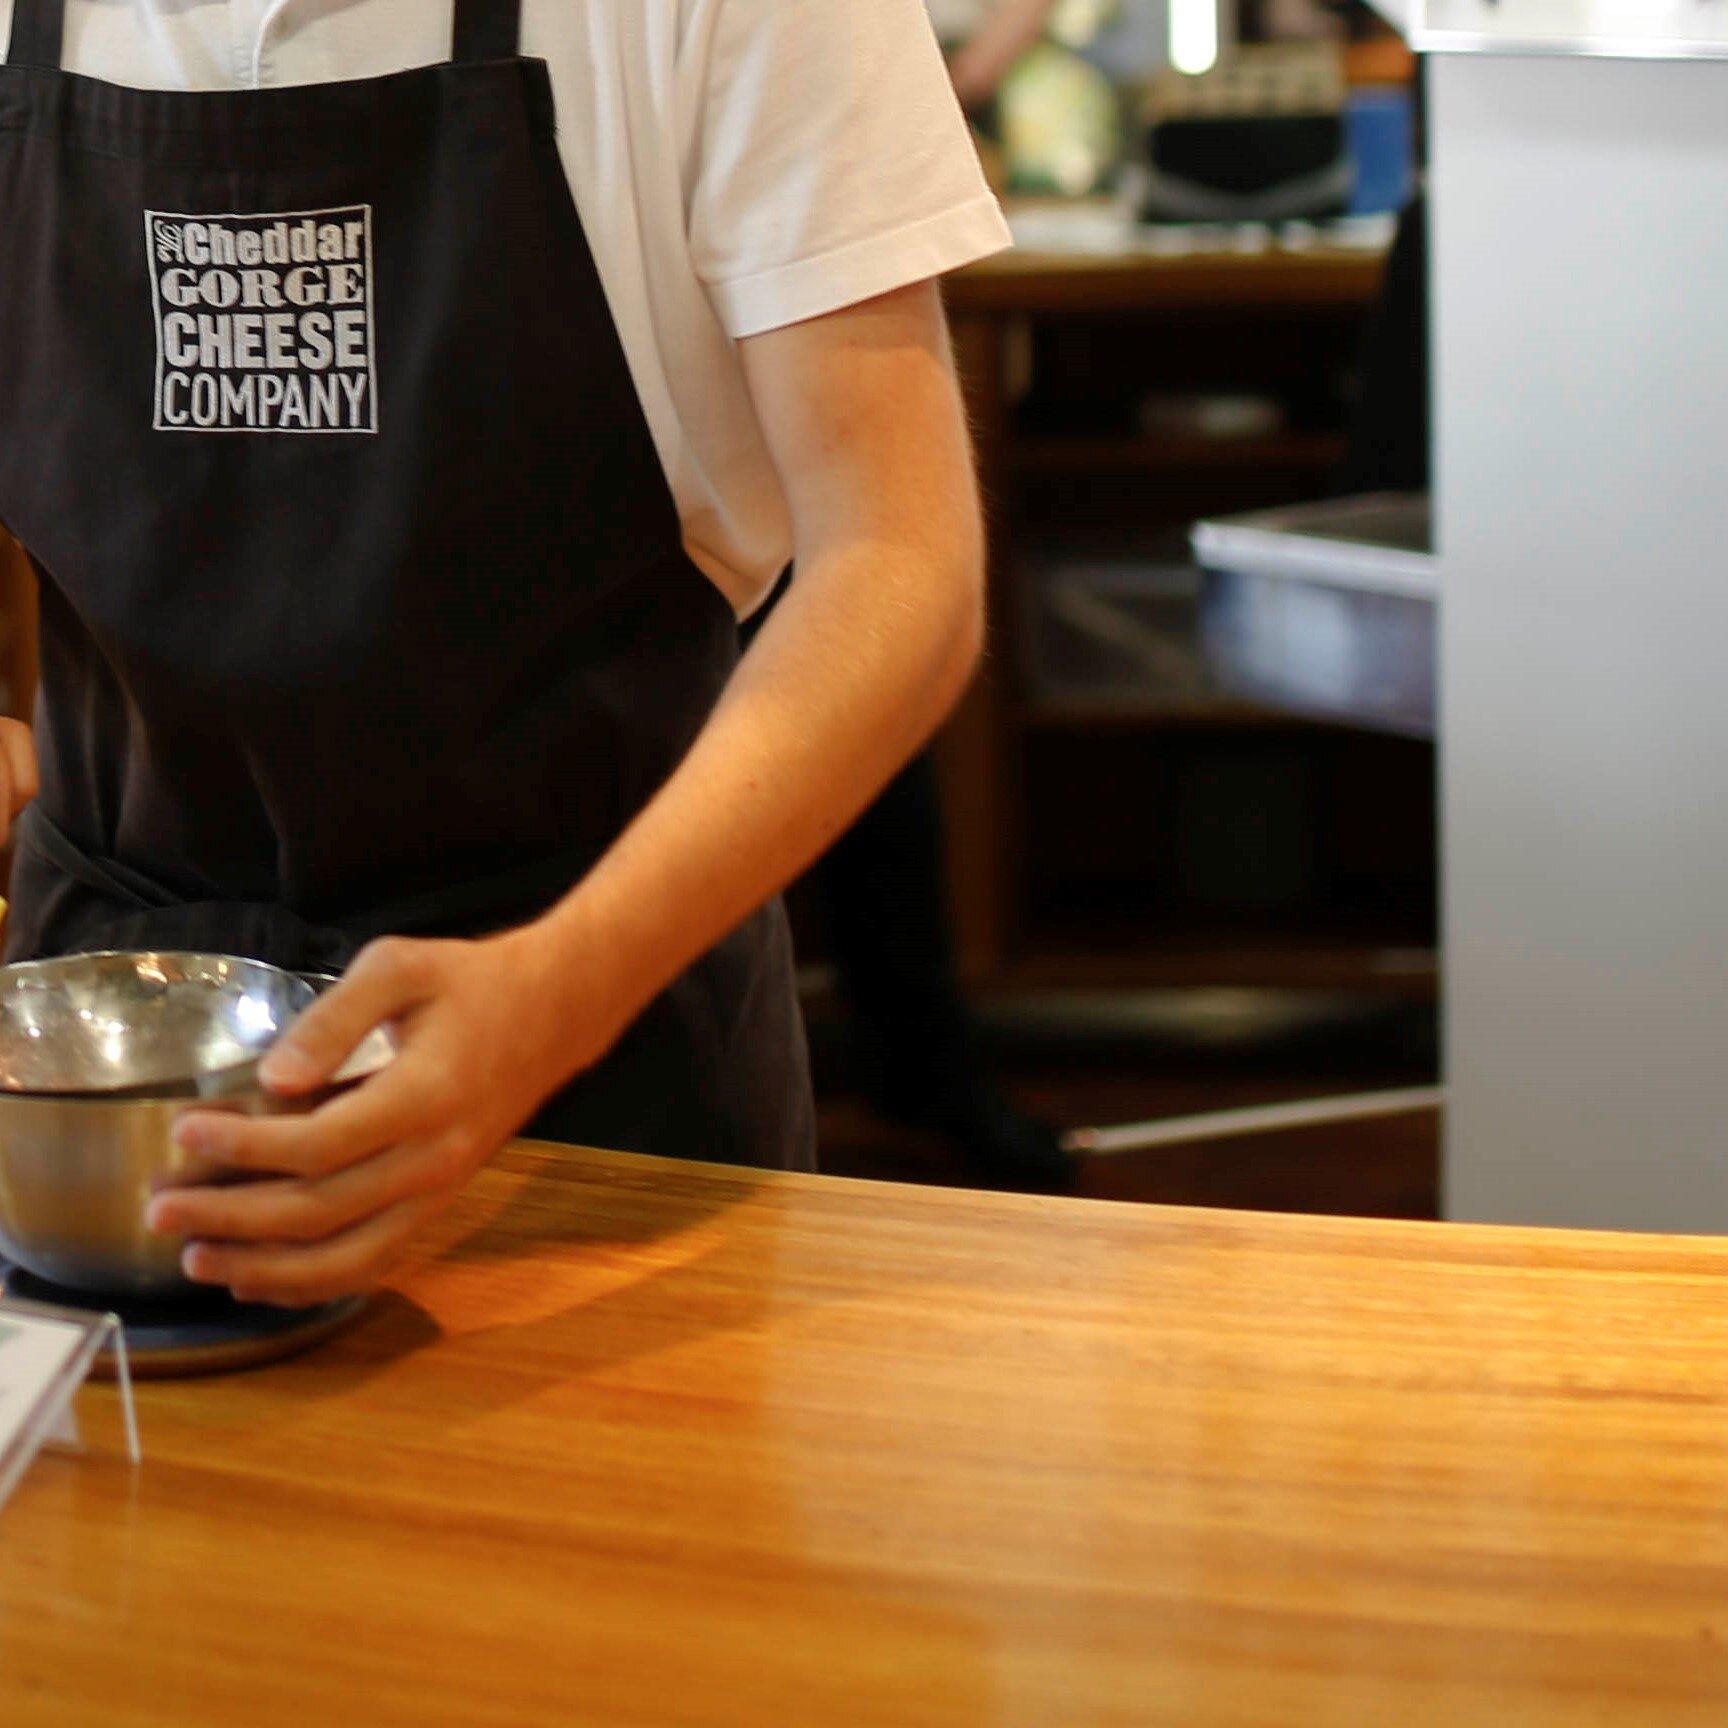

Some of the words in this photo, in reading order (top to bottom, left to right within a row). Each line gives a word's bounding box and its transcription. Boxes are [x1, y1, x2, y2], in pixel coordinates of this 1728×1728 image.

[183, 219, 364, 266] Cheddar
[160, 263, 365, 308] GORGE
[163, 310, 368, 371] CHEESE
[163, 371, 369, 427] COMPANY
